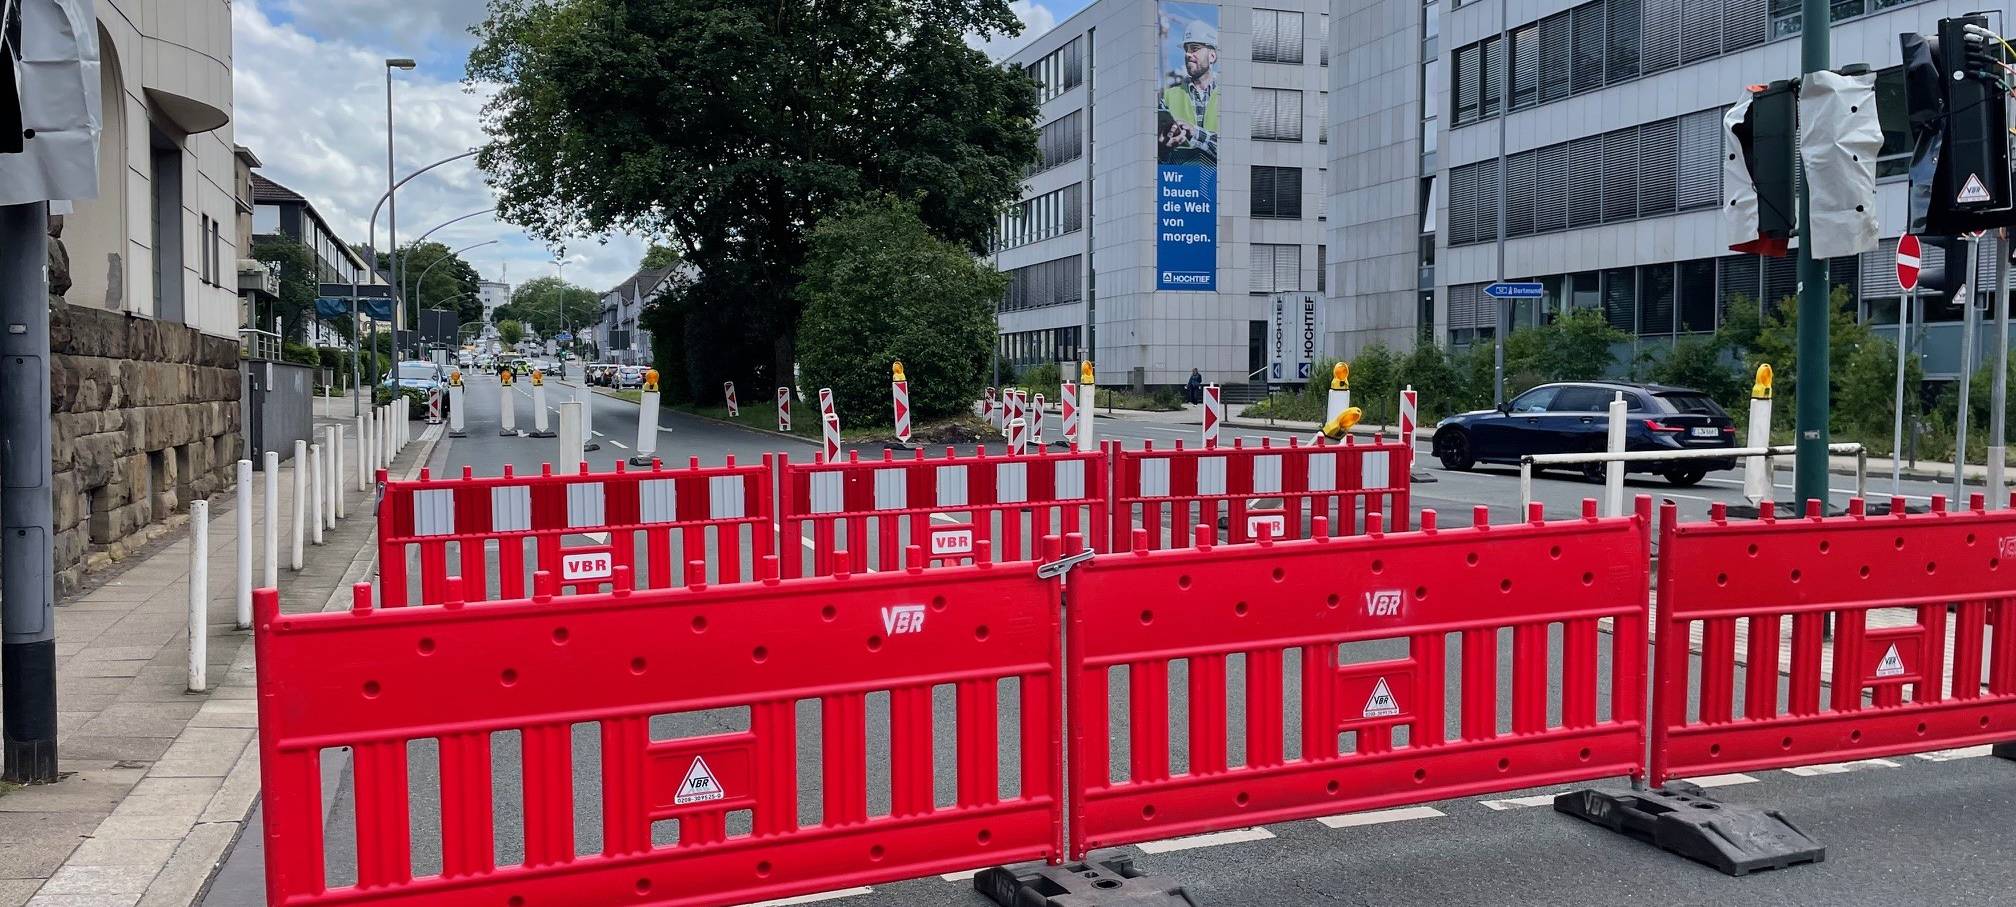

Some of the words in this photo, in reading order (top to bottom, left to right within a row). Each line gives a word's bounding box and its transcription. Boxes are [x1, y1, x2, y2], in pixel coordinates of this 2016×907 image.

[1163, 171, 1184, 182] Wir
[1163, 186, 1199, 198] bauen
[1163, 201, 1181, 212] die
[1184, 202, 1210, 213] Welt
[1163, 218, 1184, 227] von
[1163, 233, 1211, 245] morgen.
[1173, 275, 1210, 283] HOCHTIEF
[1304, 296, 1314, 359] HOCHTIEF
[1252, 521, 1281, 532] VR
[936, 536, 968, 548] VBR
[568, 559, 607, 573] VBR
[1365, 590, 1402, 617] VBR
[881, 605, 926, 638] VBR
[1373, 695, 1389, 705] VBR
[689, 776, 710, 789] VBR
